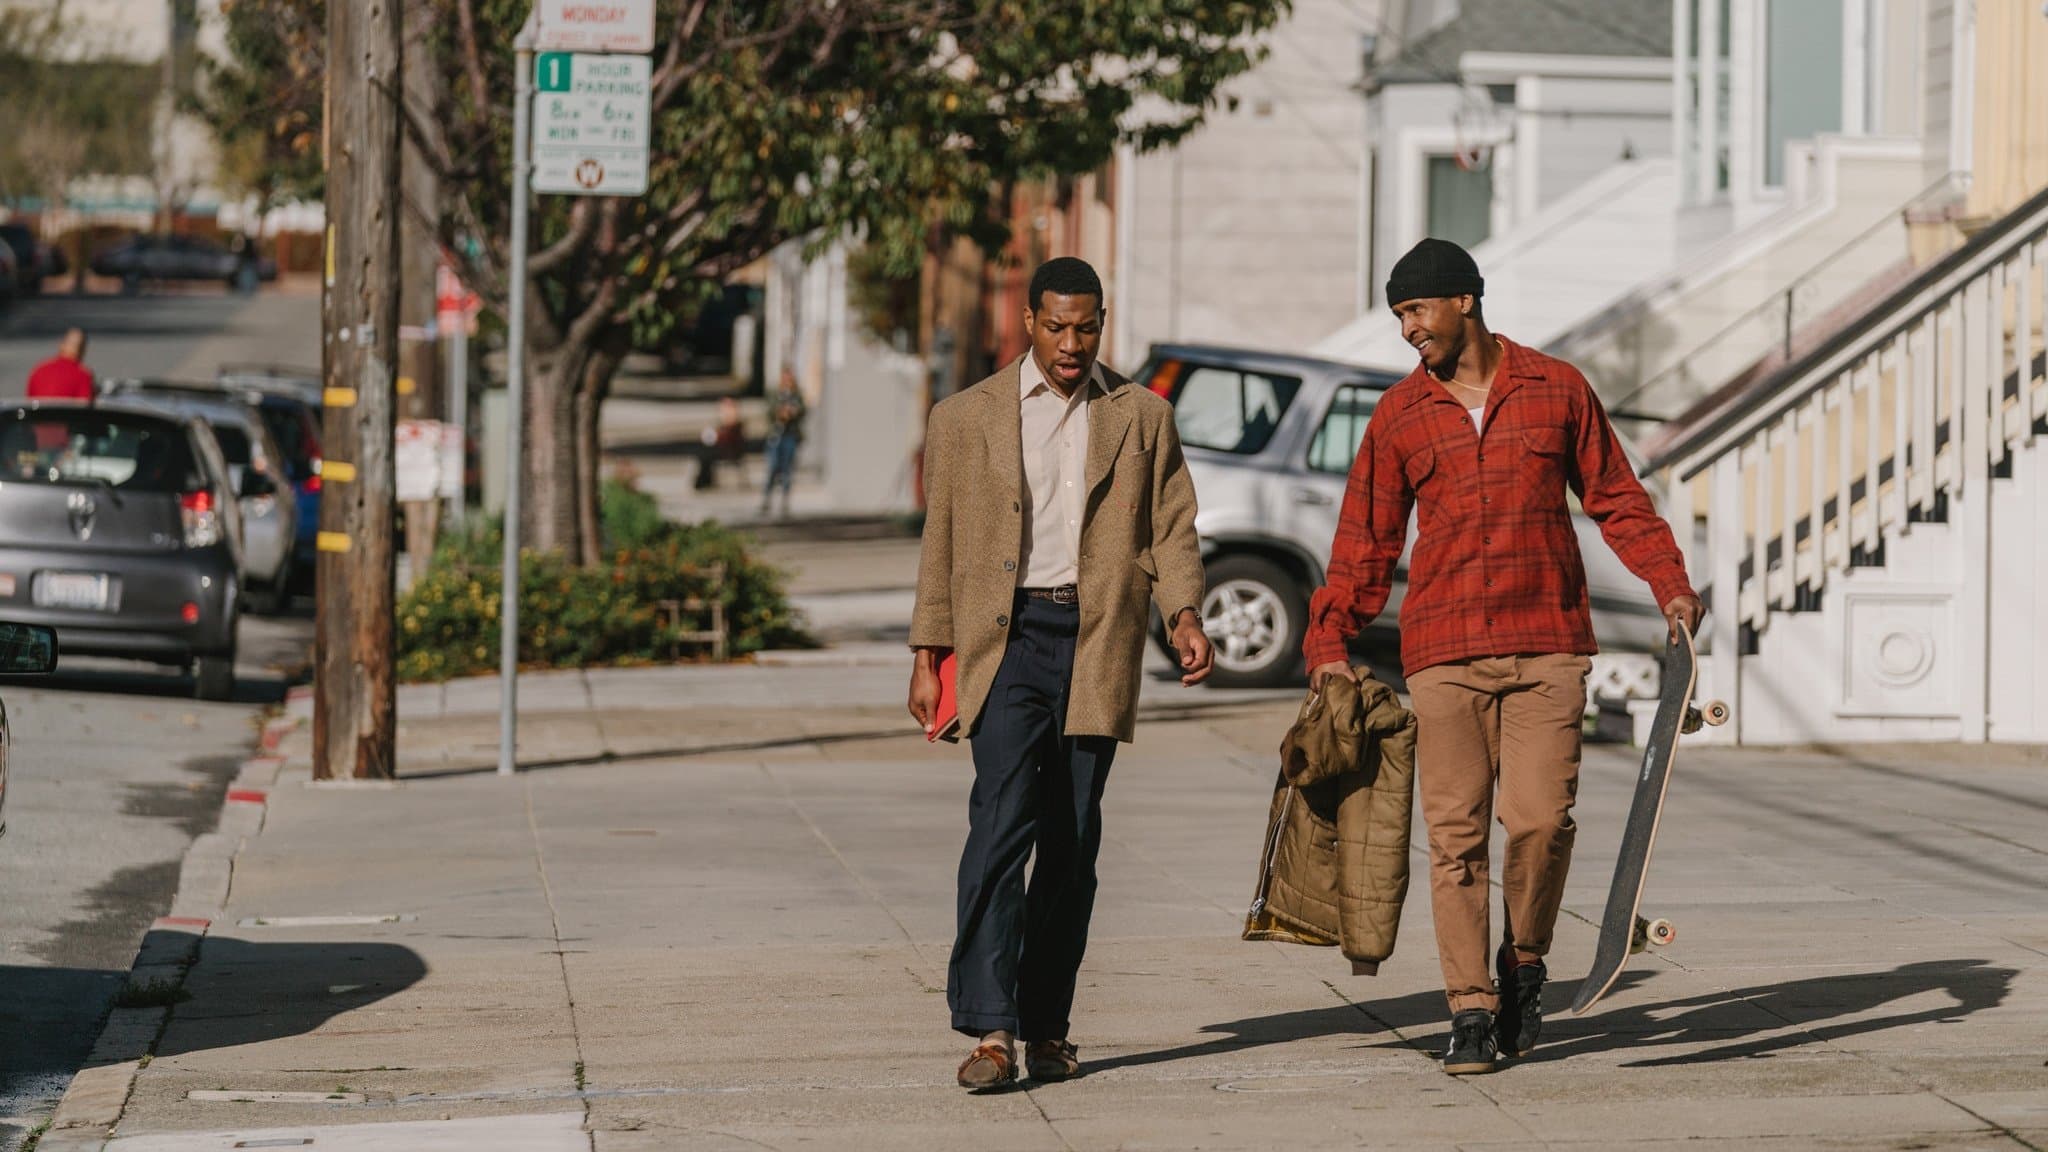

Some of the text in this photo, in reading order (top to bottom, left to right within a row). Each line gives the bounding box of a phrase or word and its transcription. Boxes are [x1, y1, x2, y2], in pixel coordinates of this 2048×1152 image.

[561, 8, 627, 22] MONDAY
[549, 58, 559, 88] 1
[588, 62, 632, 76] HOUR
[576, 81, 643, 96] PARKING
[548, 127, 578, 141] MON
